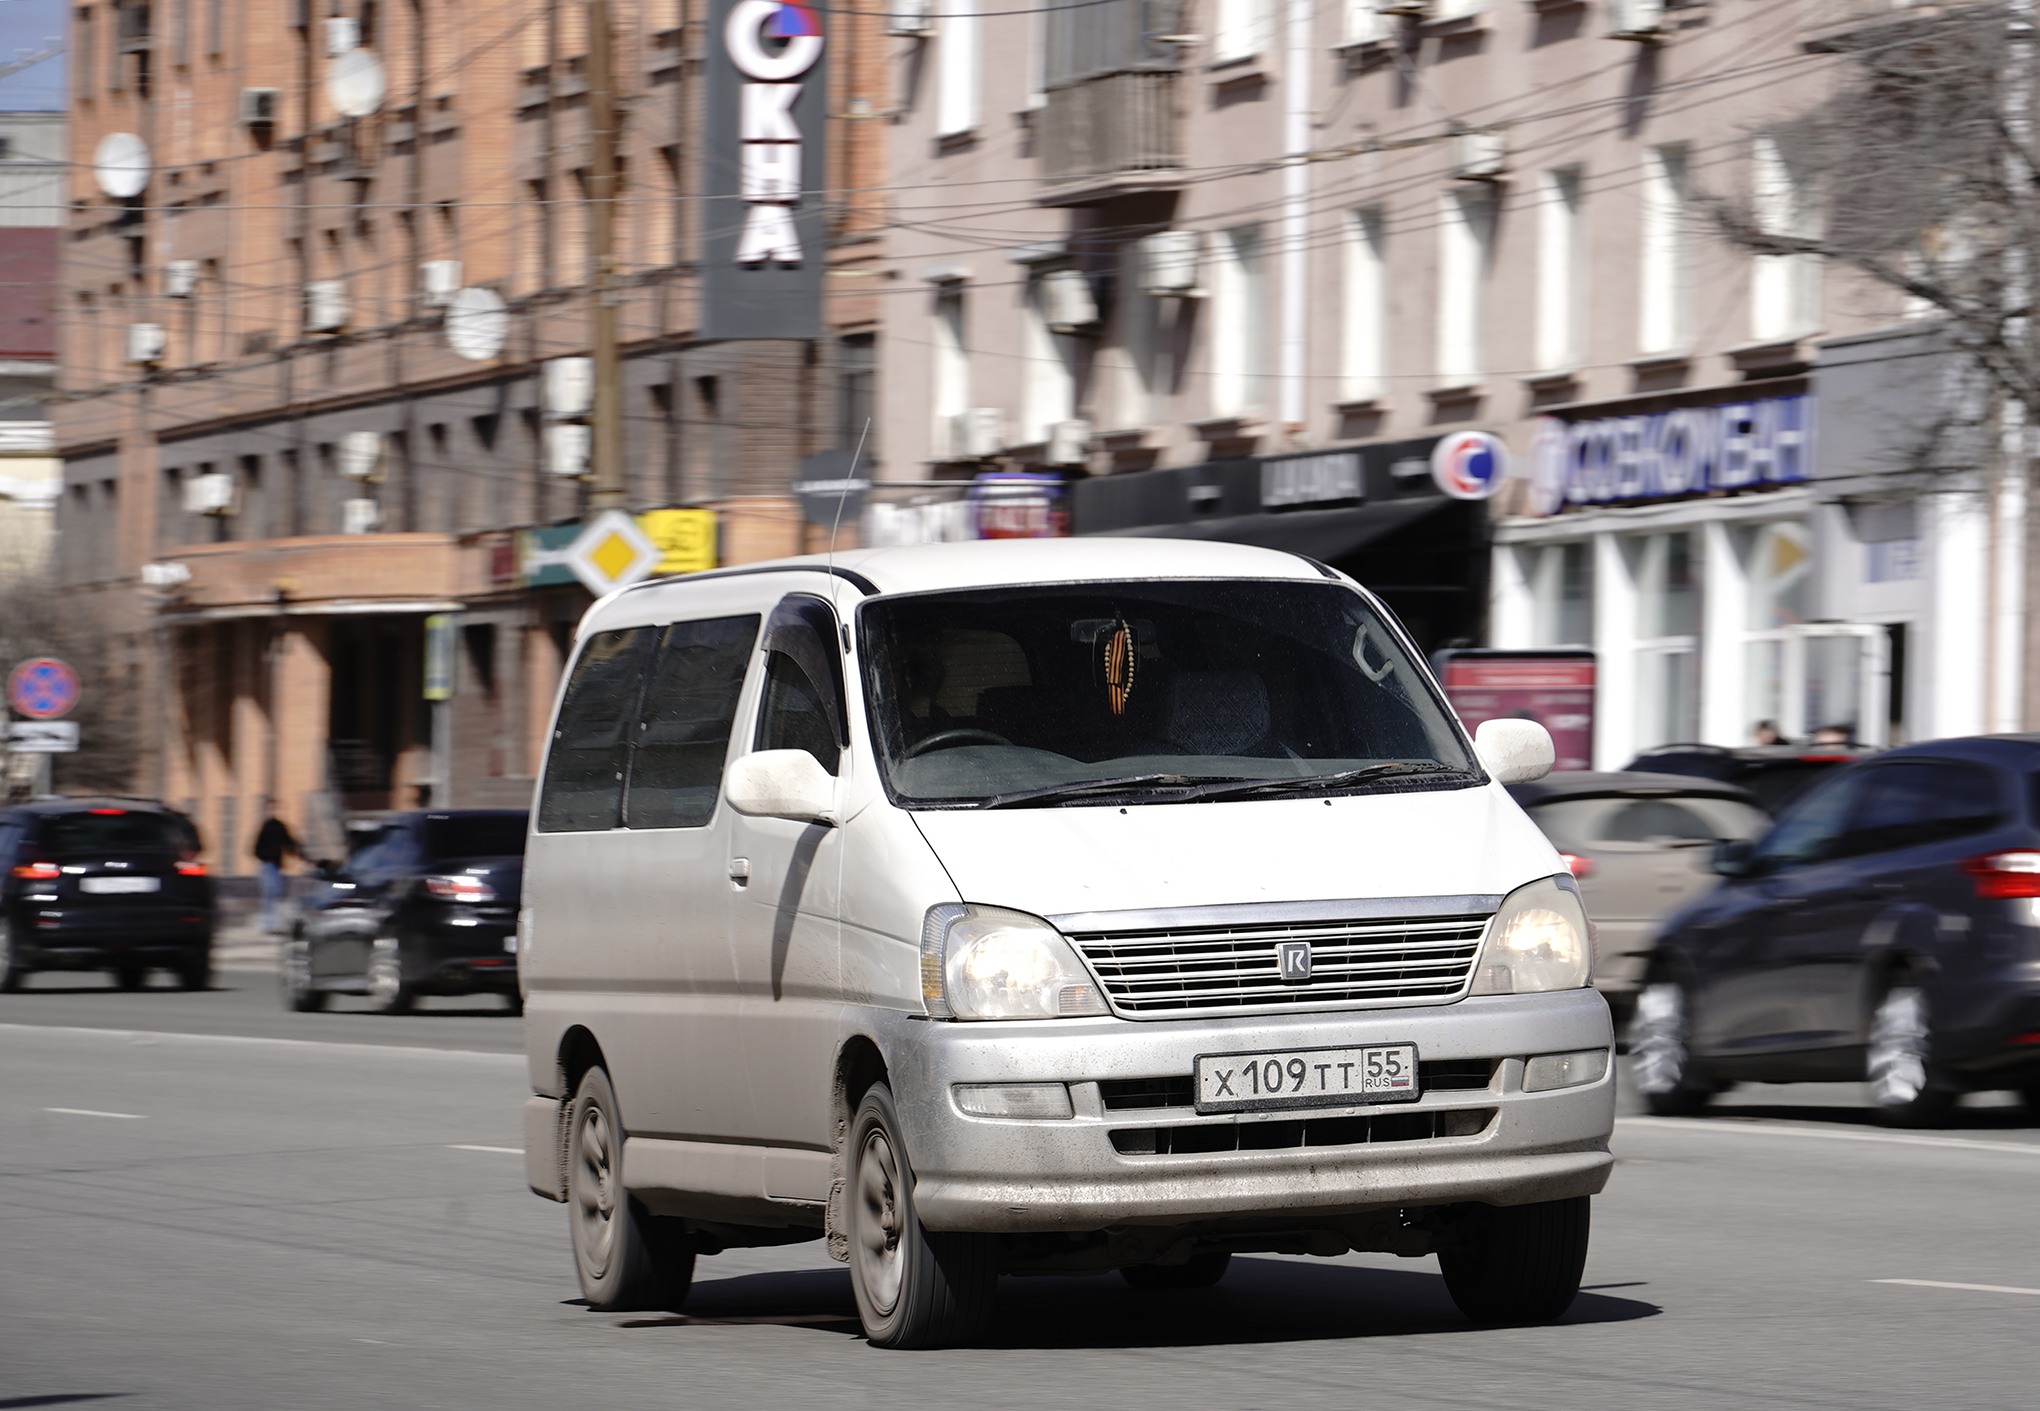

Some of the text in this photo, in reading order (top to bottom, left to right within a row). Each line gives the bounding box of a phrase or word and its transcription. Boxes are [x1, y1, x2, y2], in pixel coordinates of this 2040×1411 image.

[724, 0, 825, 263] ОКНА
[1366, 1050, 1401, 1078] 55
[1365, 1077, 1390, 1088] RUS
